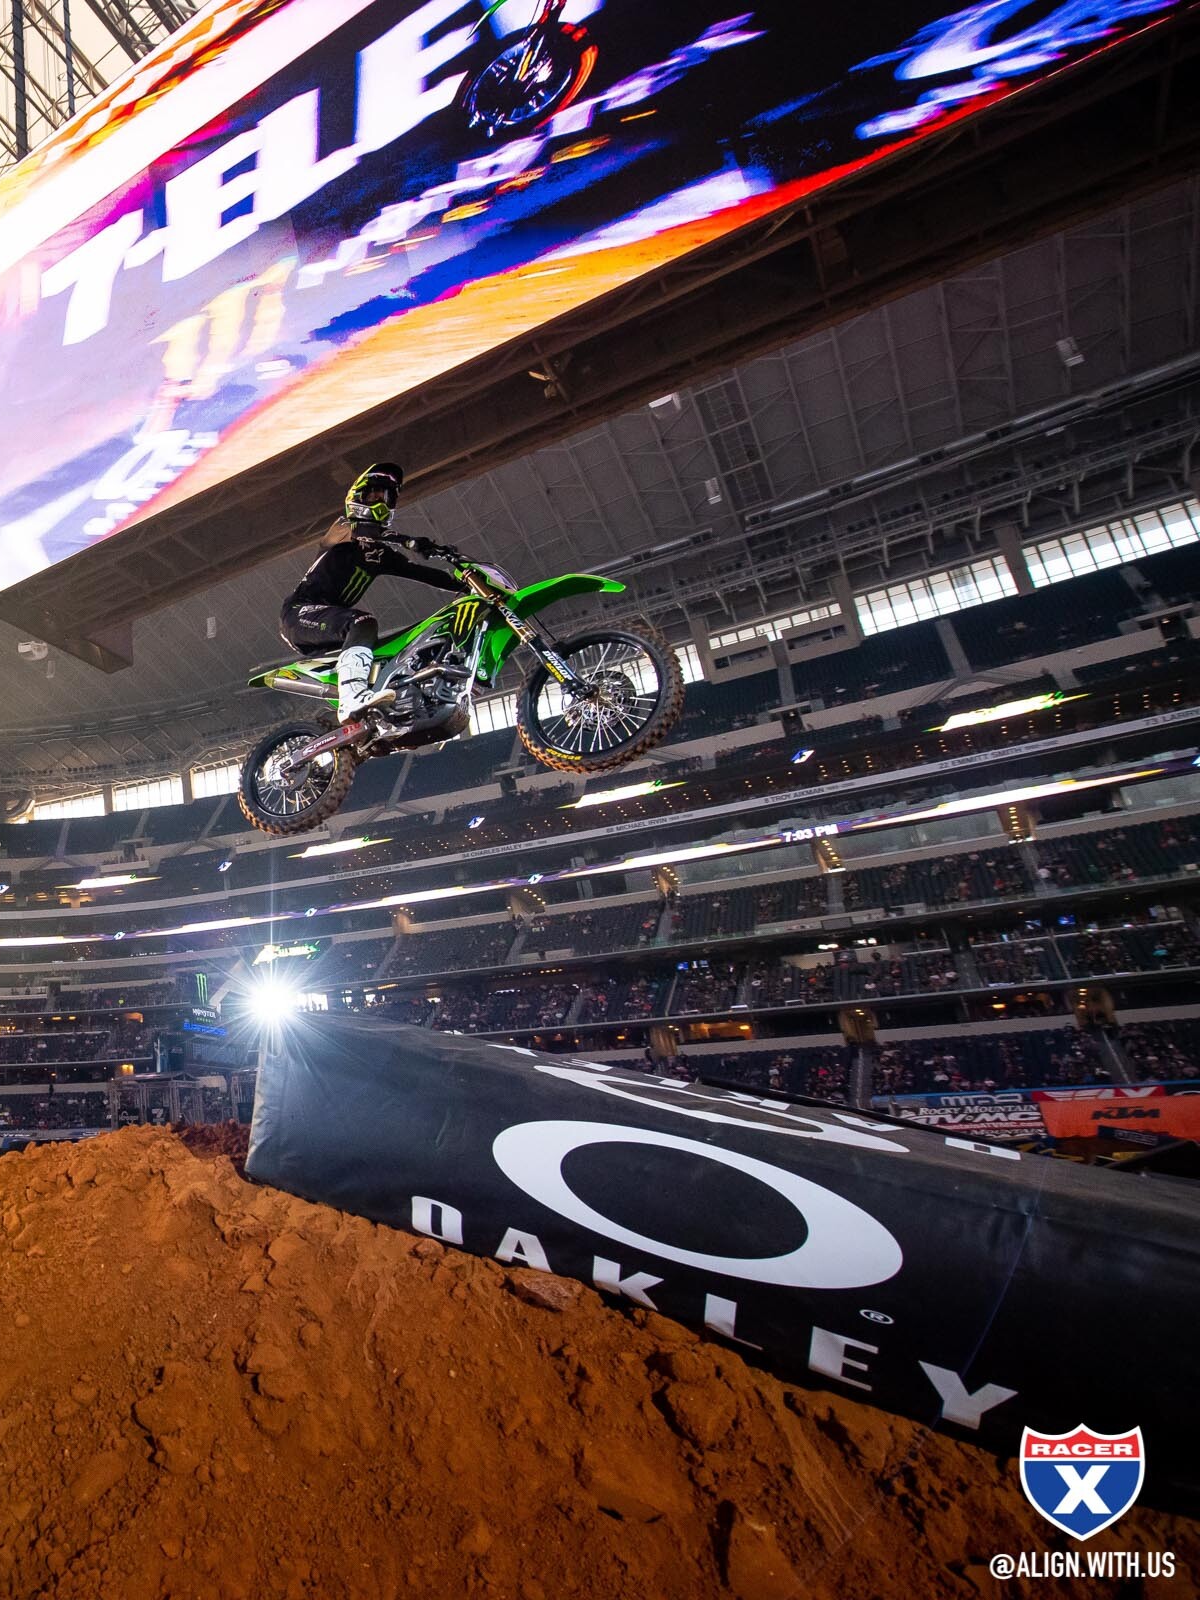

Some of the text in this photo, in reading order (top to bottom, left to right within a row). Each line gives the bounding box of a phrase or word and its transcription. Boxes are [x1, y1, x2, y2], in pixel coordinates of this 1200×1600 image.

[542, 650, 574, 681] DUNLOP
[783, 823, 840, 843] 7:03 PM
[919, 1103, 1039, 1116] ROCKY MOUNTAIN
[1091, 1106, 1161, 1120] KTM
[410, 1194, 1019, 1431] OAKLEY
